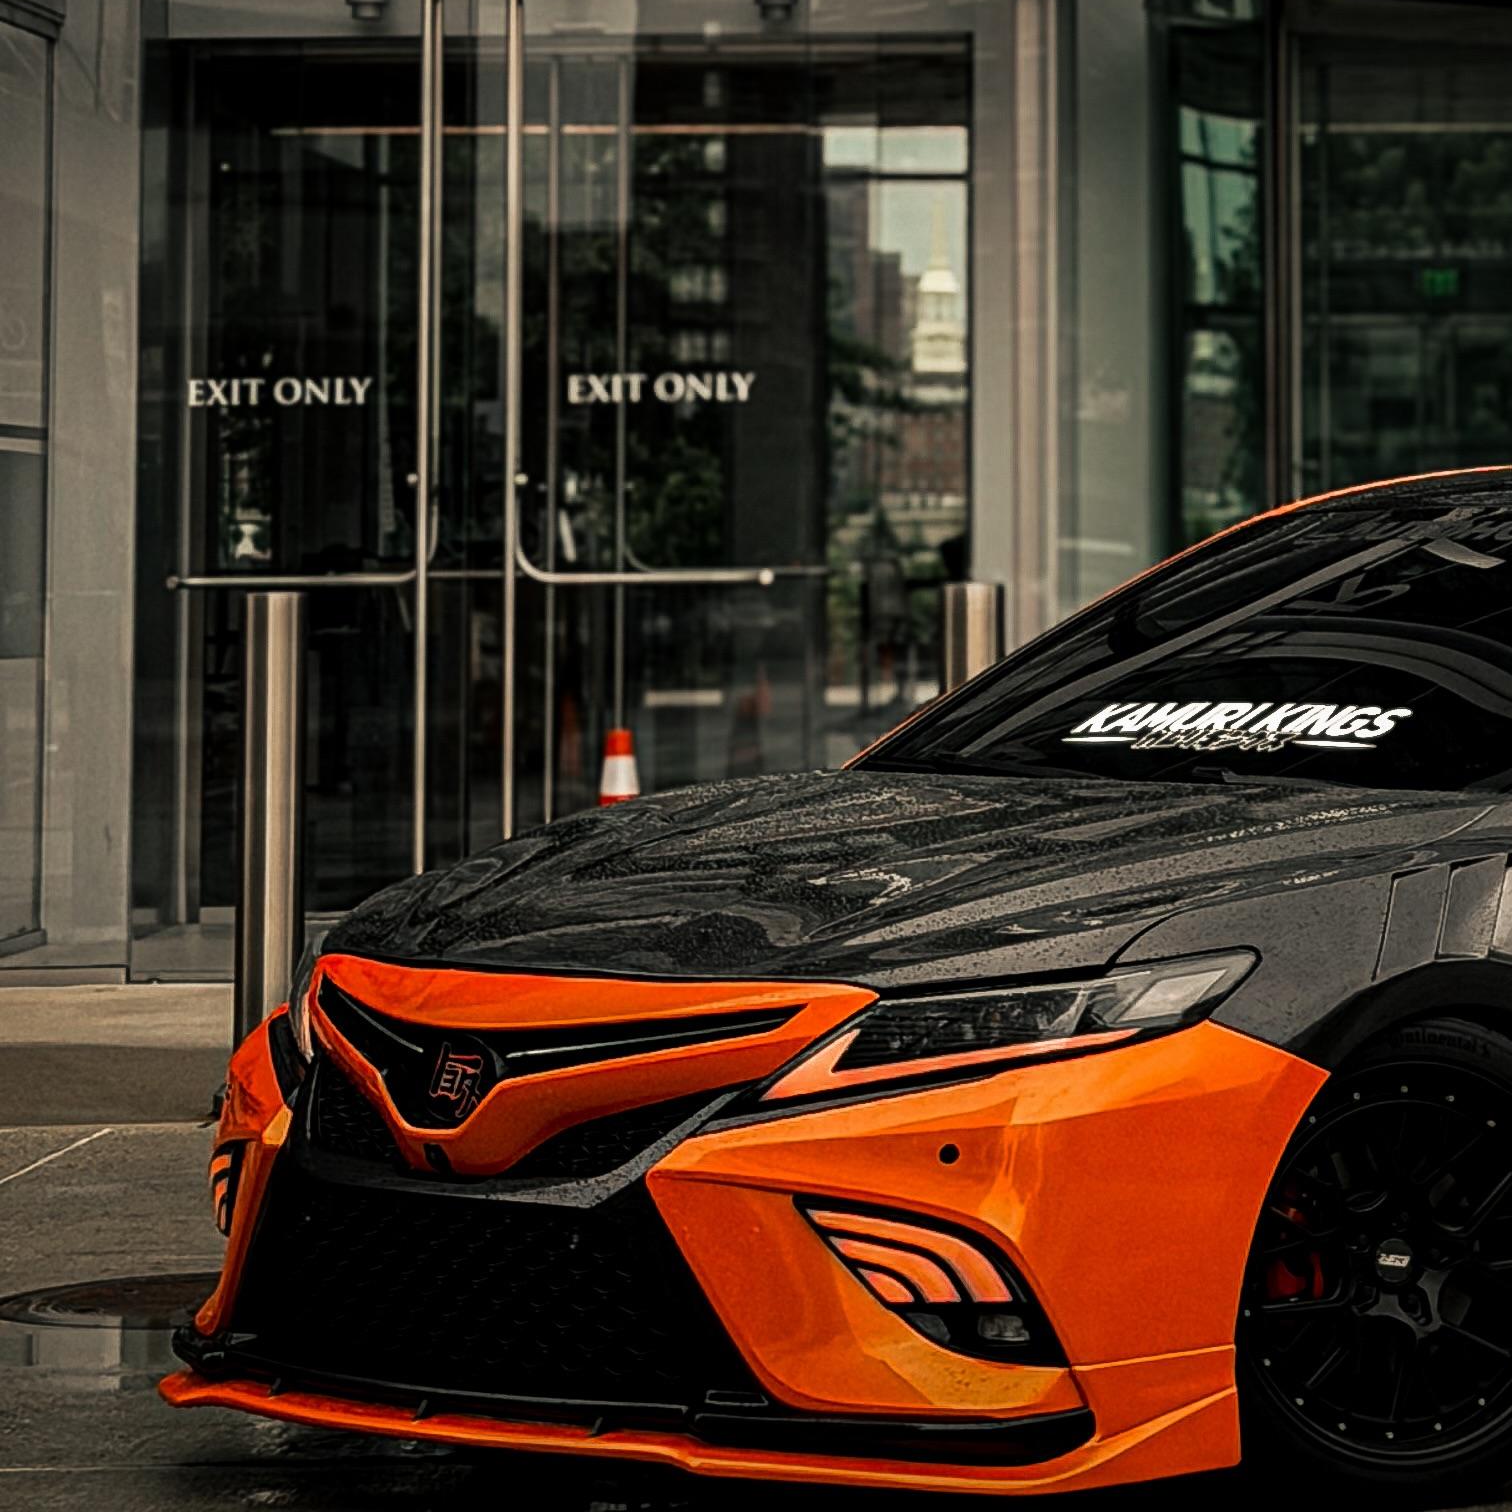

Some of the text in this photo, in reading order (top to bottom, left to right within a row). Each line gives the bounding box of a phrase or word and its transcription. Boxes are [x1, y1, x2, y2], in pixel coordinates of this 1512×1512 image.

[188, 377, 373, 407] EXIT ONLY
[566, 371, 756, 405] EXIT ONLY
[1070, 702, 1413, 738] KAMURI KINGS
